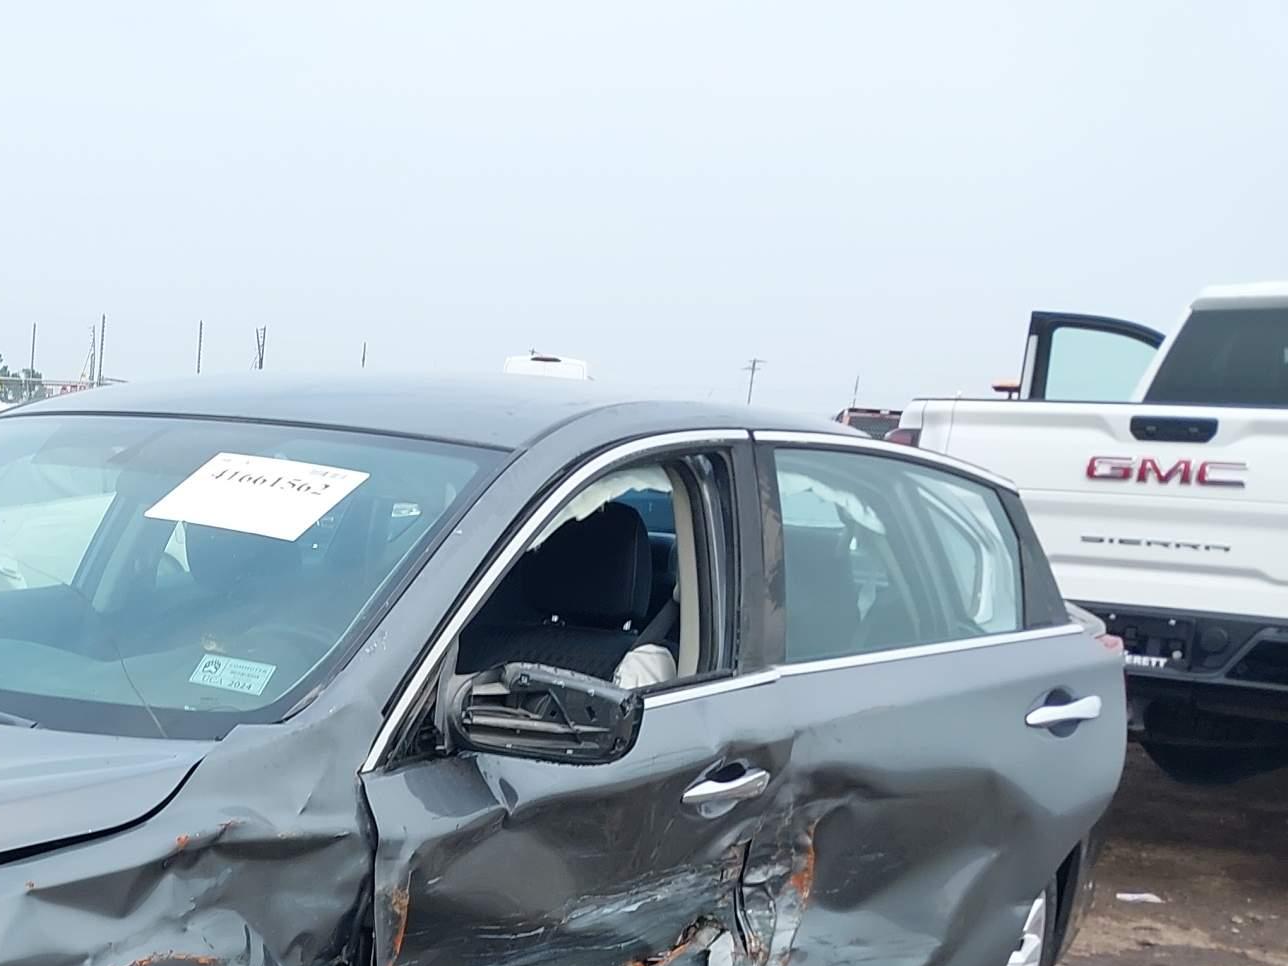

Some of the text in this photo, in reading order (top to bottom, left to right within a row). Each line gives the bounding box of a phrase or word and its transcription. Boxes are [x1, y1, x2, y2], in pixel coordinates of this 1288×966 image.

[210, 468, 331, 496] 41661562
[1085, 455, 1250, 489] GMC
[1080, 535, 1231, 552] SIERRA
[227, 680, 253, 690] 2024
